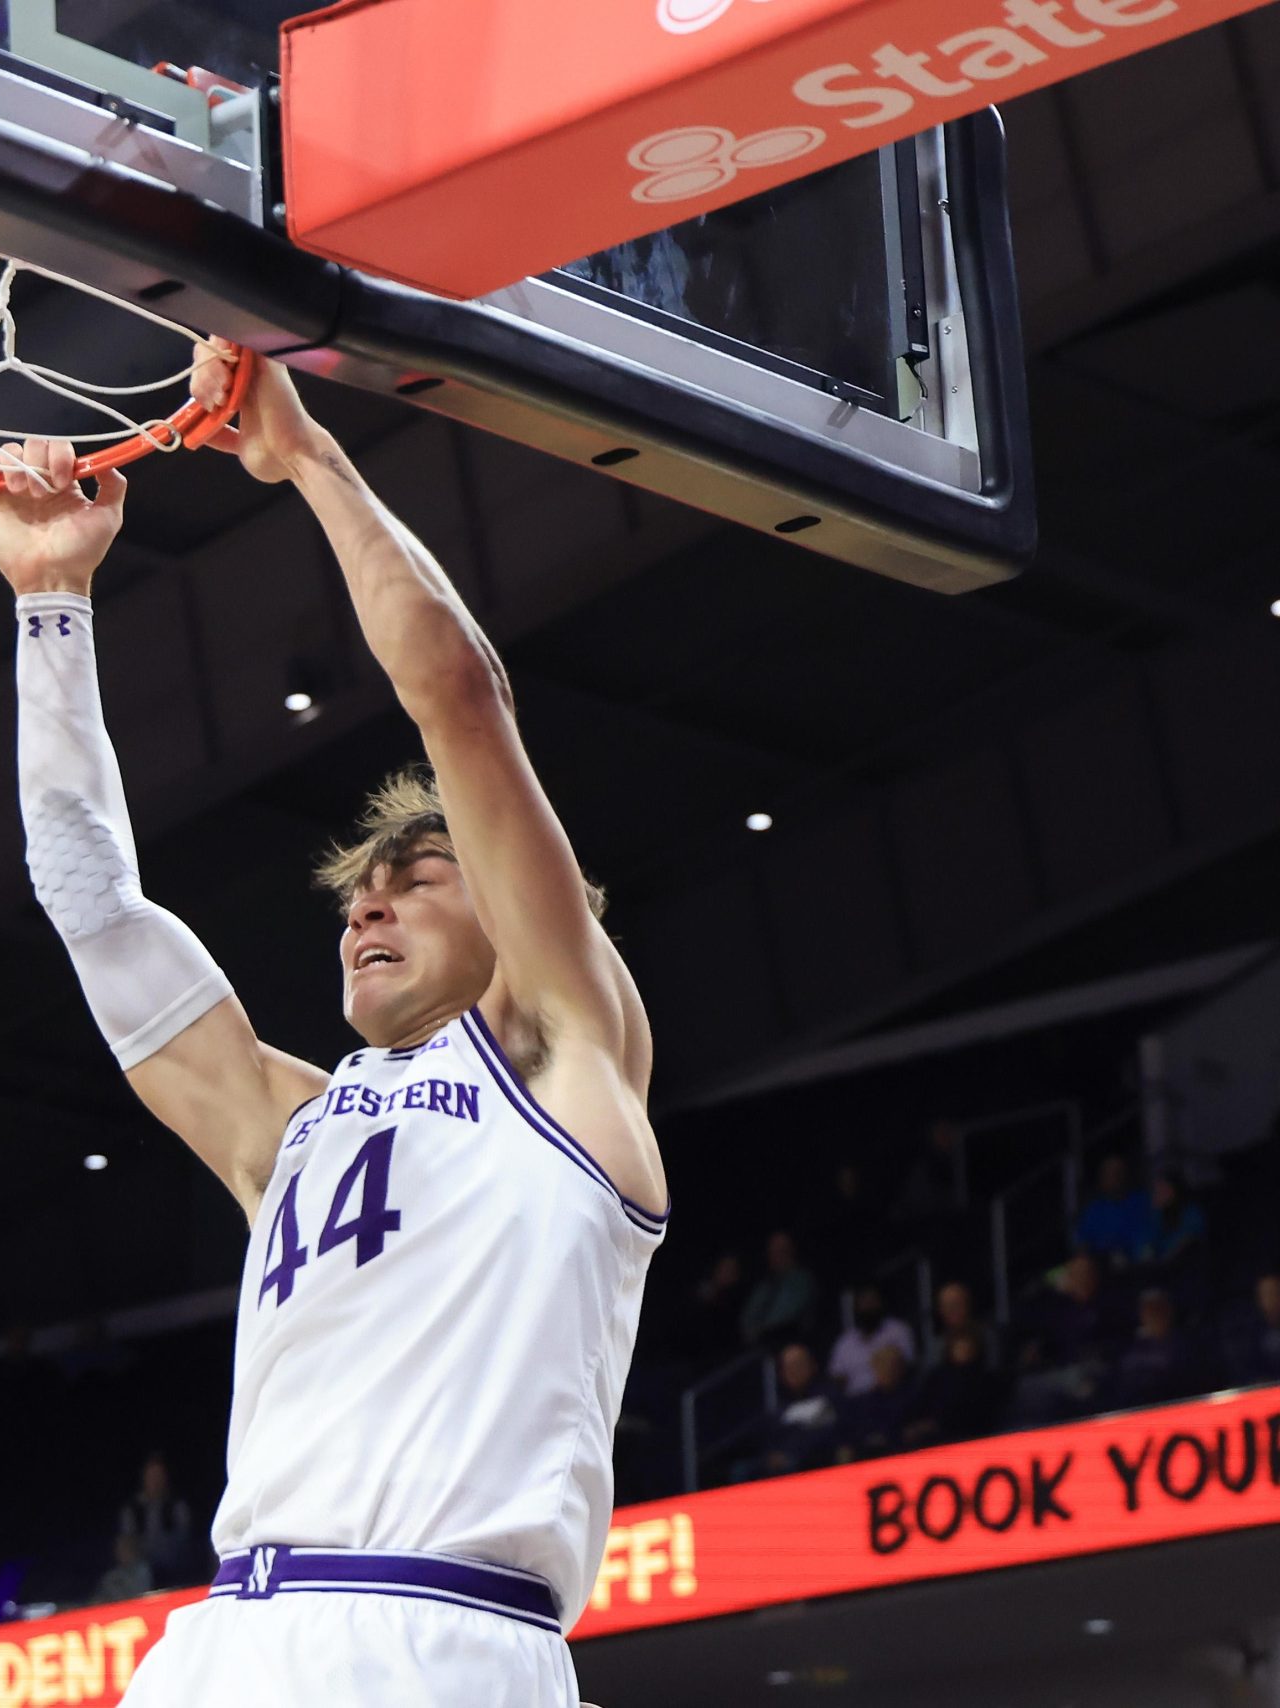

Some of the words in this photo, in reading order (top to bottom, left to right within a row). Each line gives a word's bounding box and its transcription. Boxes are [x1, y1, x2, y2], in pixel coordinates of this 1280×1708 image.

[258, 1125, 401, 1312] 44
[867, 1453, 1074, 1555] BOOK
[248, 1546, 277, 1593] N
[590, 1512, 698, 1611] FF!
